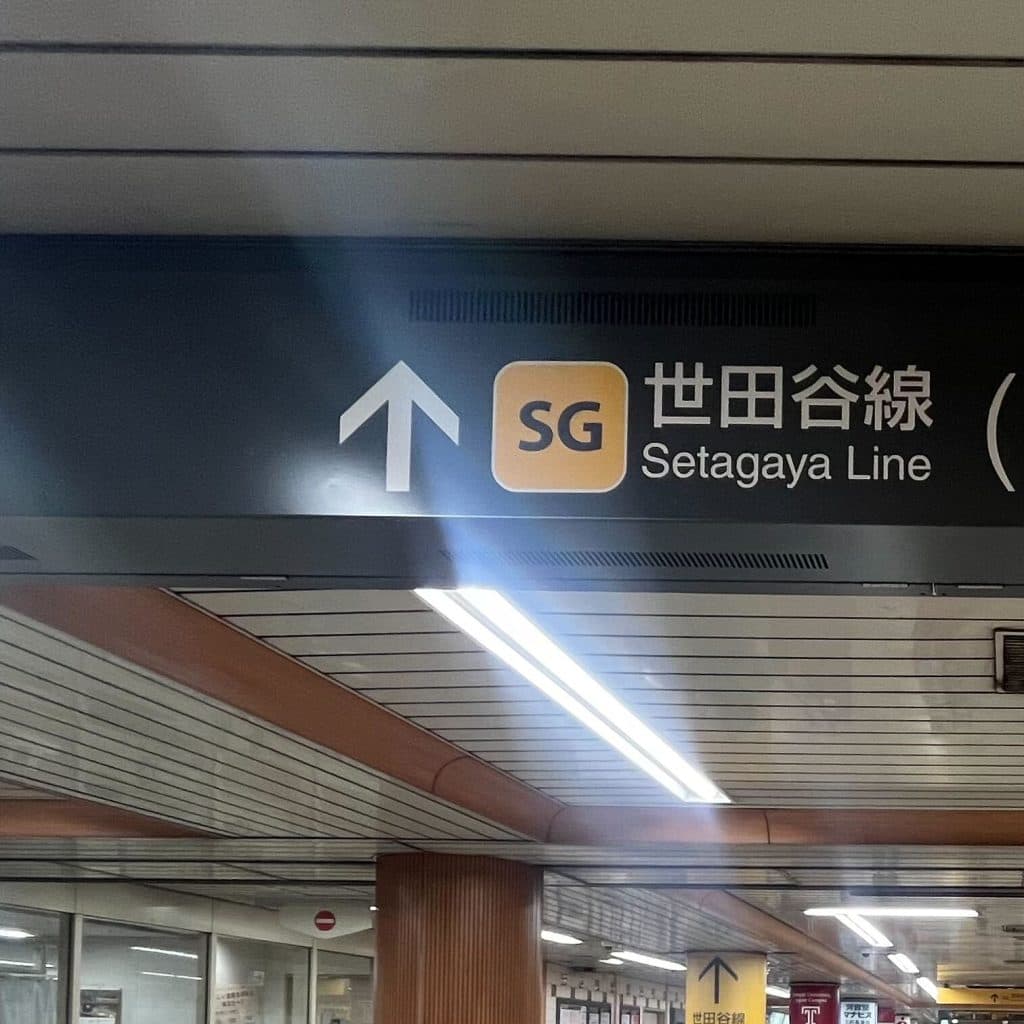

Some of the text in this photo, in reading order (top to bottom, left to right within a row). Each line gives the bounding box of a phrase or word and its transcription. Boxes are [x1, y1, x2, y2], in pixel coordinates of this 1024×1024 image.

[644, 361, 934, 432] 世田谷線
[517, 400, 603, 453] SG
[641, 442, 932, 488] Setagaya Line
